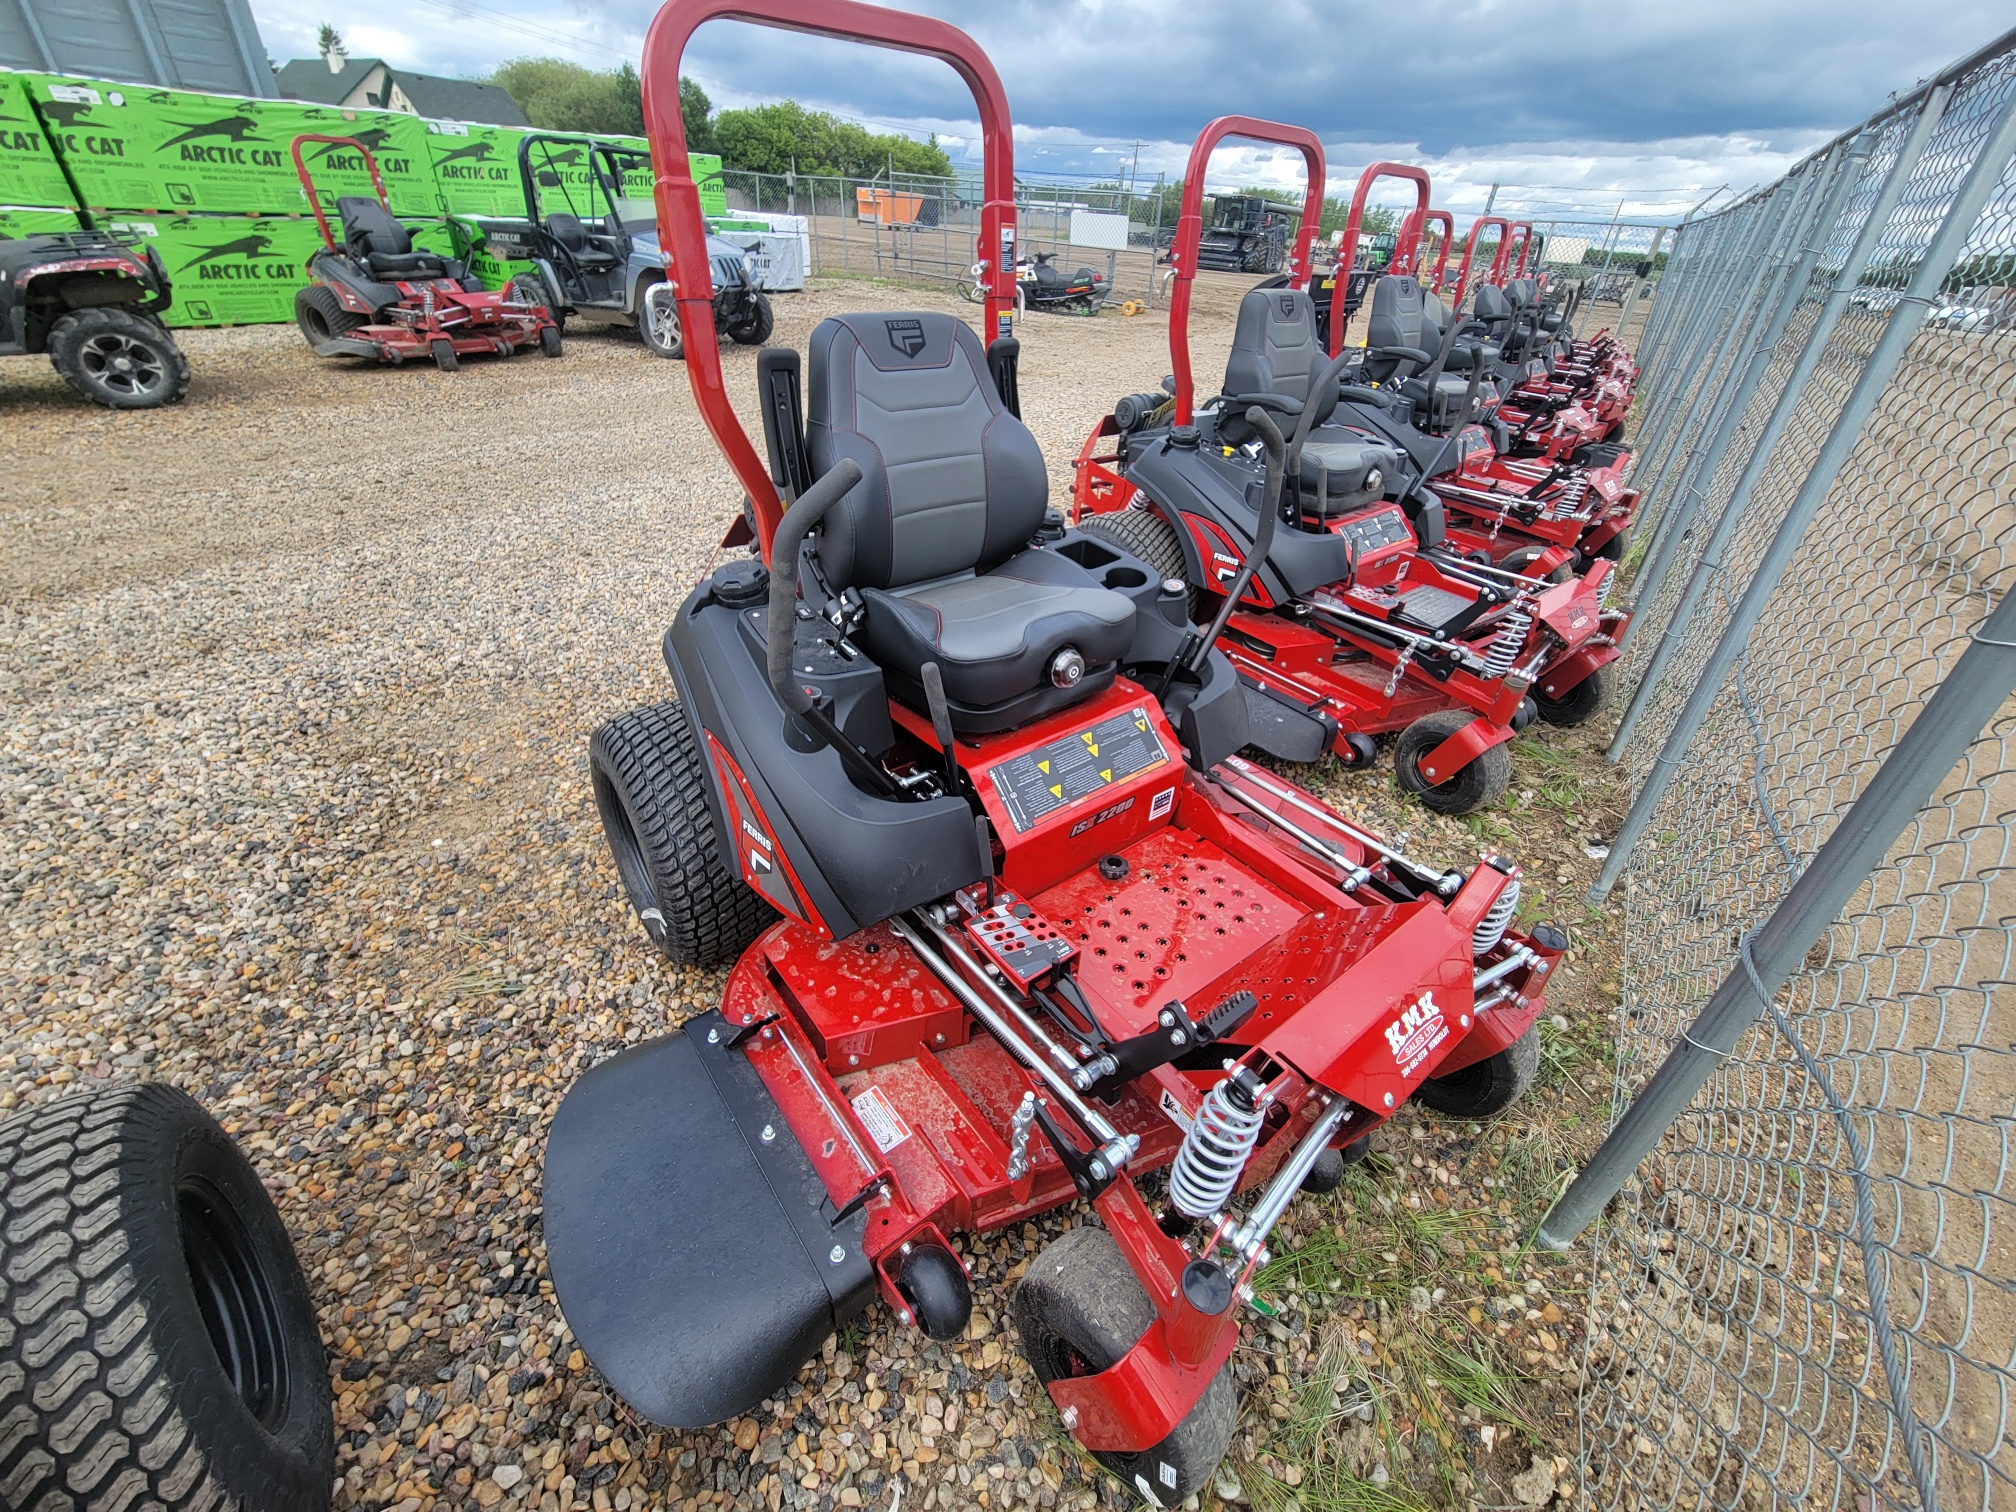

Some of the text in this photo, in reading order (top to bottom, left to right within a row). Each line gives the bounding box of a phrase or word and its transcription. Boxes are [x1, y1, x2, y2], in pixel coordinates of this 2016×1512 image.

[85, 136, 124, 156] CAT
[181, 144, 282, 167] ARCTIC CAT
[384, 157, 410, 173] CAT
[442, 164, 509, 180] ARCTIC CAT
[491, 232, 521, 243] ARCTIC CAT
[198, 264, 295, 280] ARCTIC CAT
[488, 261, 501, 275] CAT
[887, 320, 920, 330] FERRIS
[1214, 552, 1240, 566] FERRIS
[1070, 815, 1098, 837] ISX
[1097, 797, 1136, 824] 2200
[743, 819, 773, 852] FERRIS
[1404, 1033, 1425, 1057] SALES
